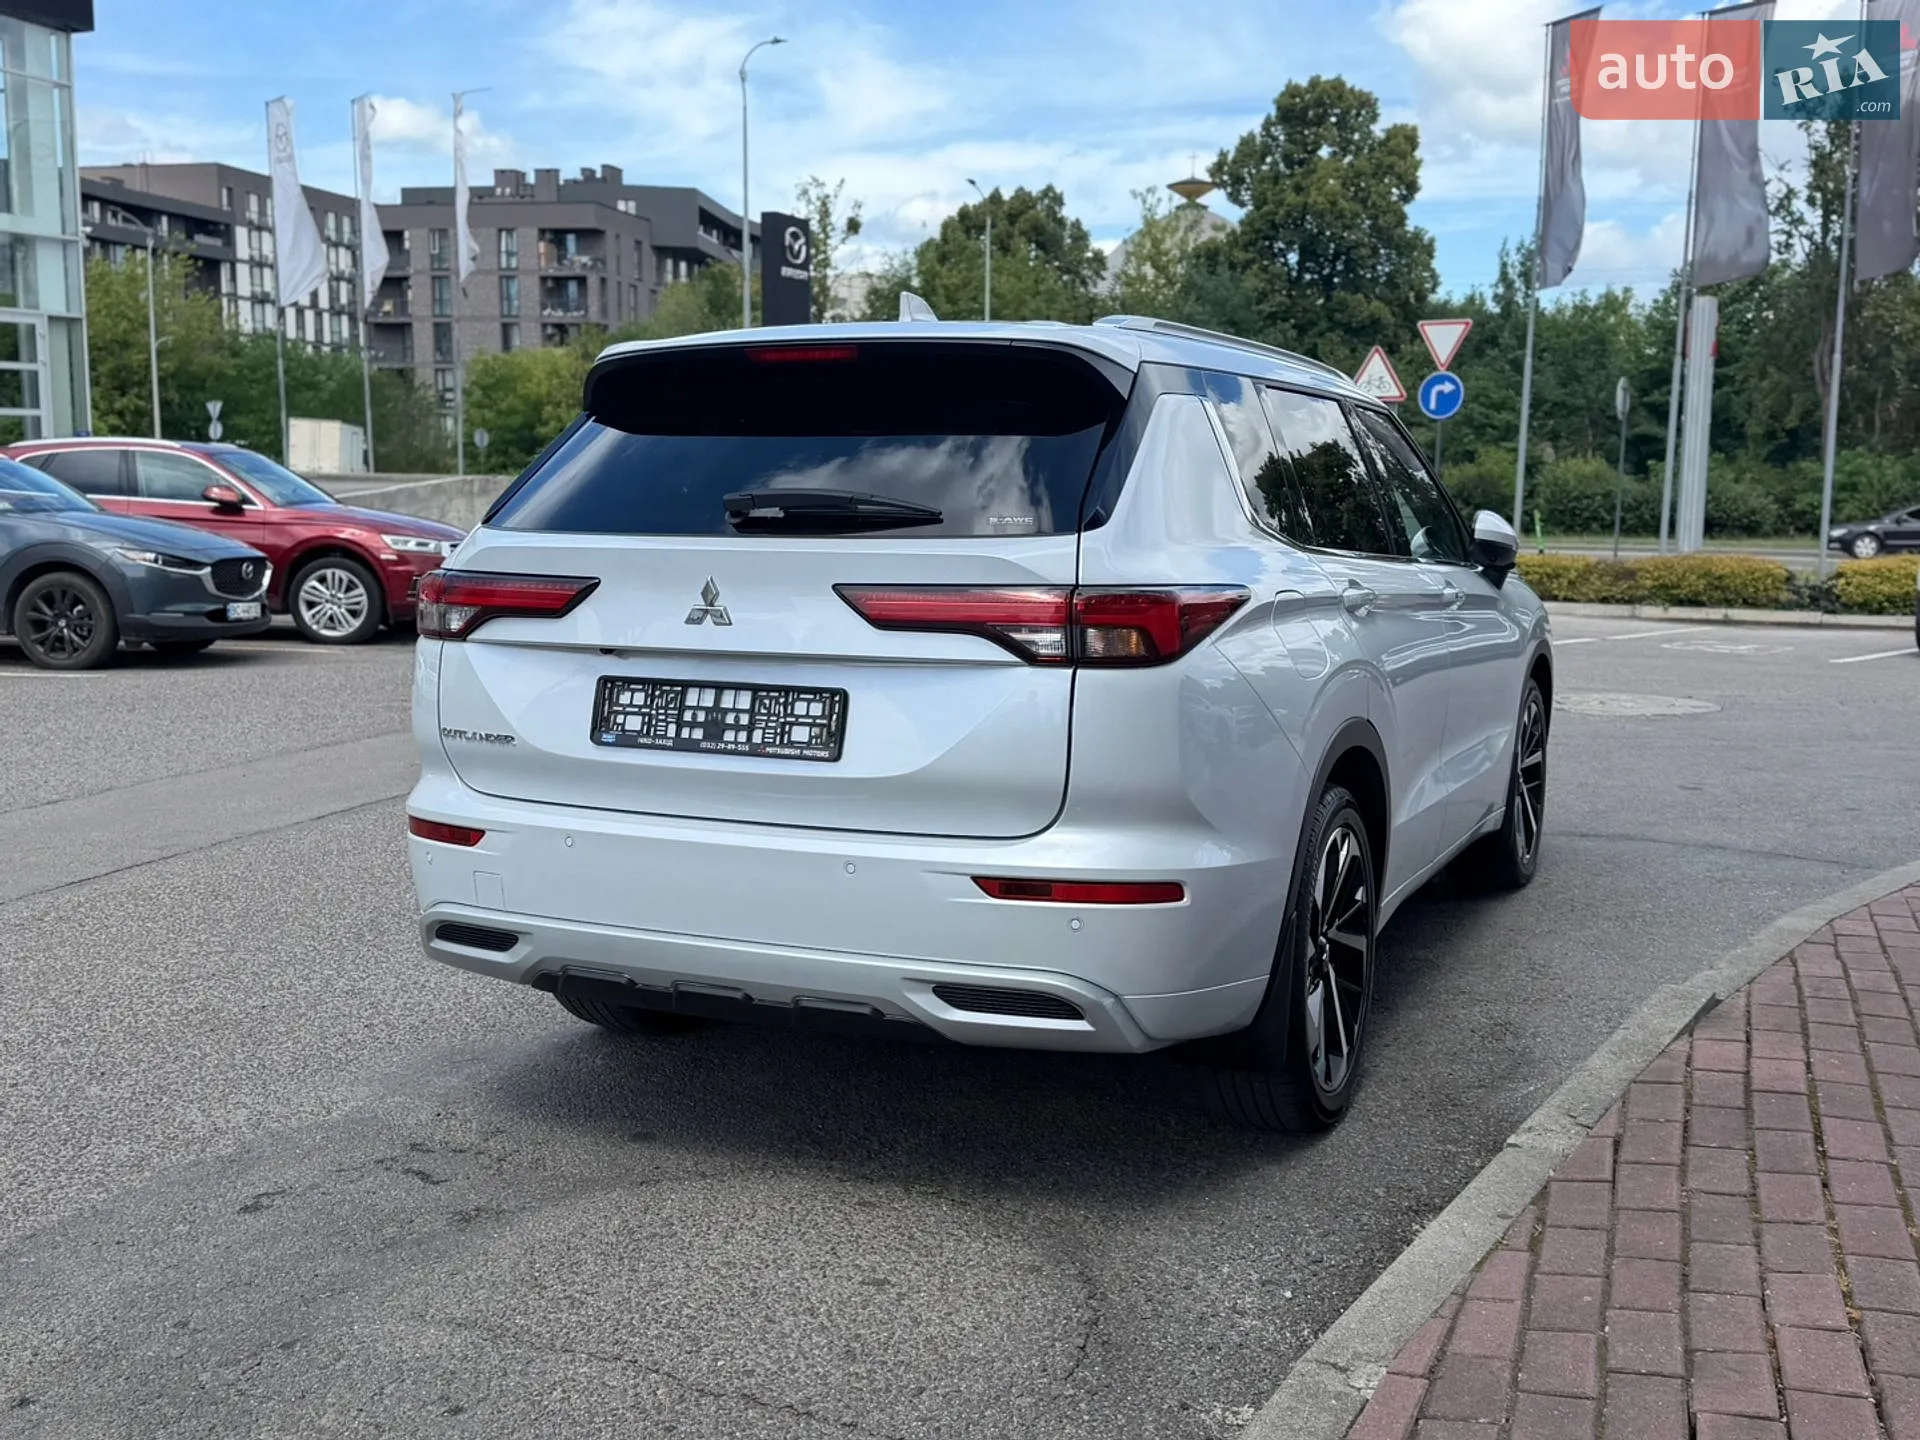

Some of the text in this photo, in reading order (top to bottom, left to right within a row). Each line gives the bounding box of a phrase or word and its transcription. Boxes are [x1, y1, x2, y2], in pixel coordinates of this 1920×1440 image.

[441, 727, 517, 745] OUTLANDER
[766, 747, 830, 758] MITSUBISHI MOTORS
